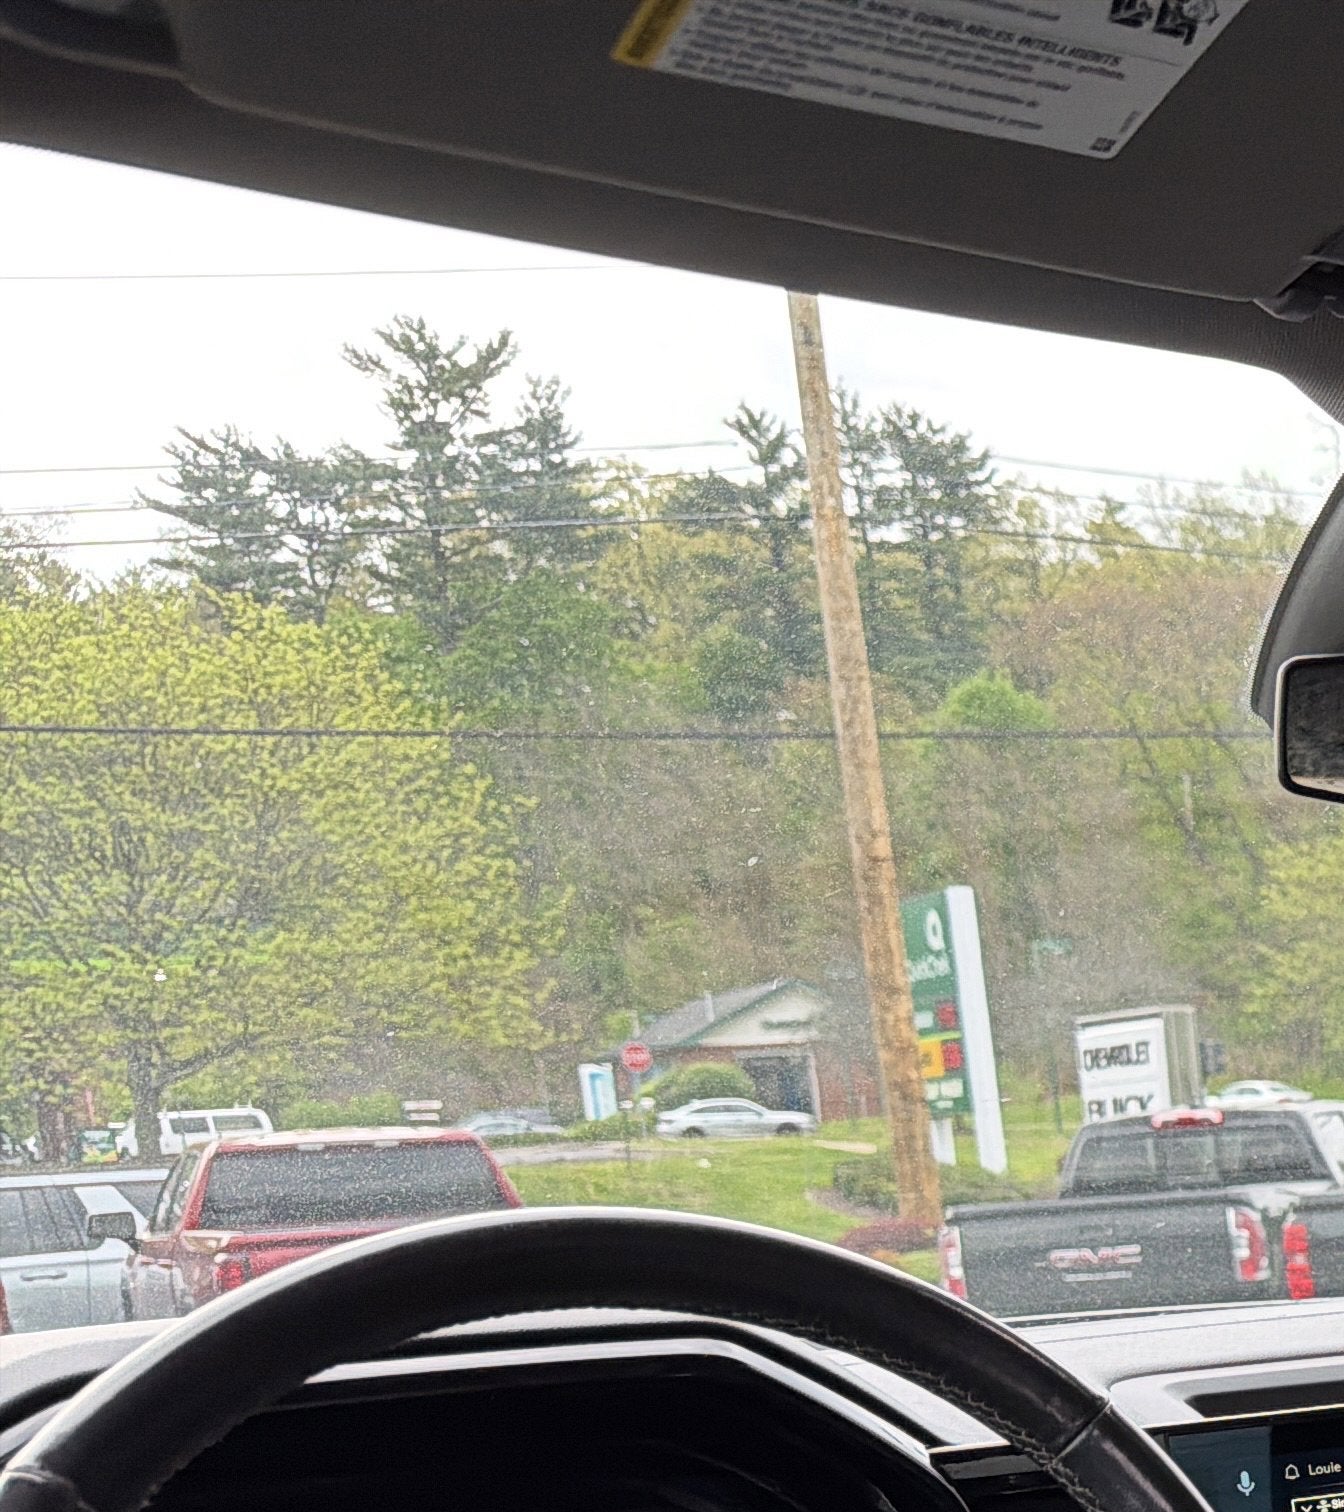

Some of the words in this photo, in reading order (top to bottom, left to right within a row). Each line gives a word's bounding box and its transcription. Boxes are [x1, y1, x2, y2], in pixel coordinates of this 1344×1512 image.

[1083, 1041, 1150, 1072] CHEVROLET
[1050, 1244, 1142, 1268] GMC
[1308, 1462, 1342, 1476] Louie
